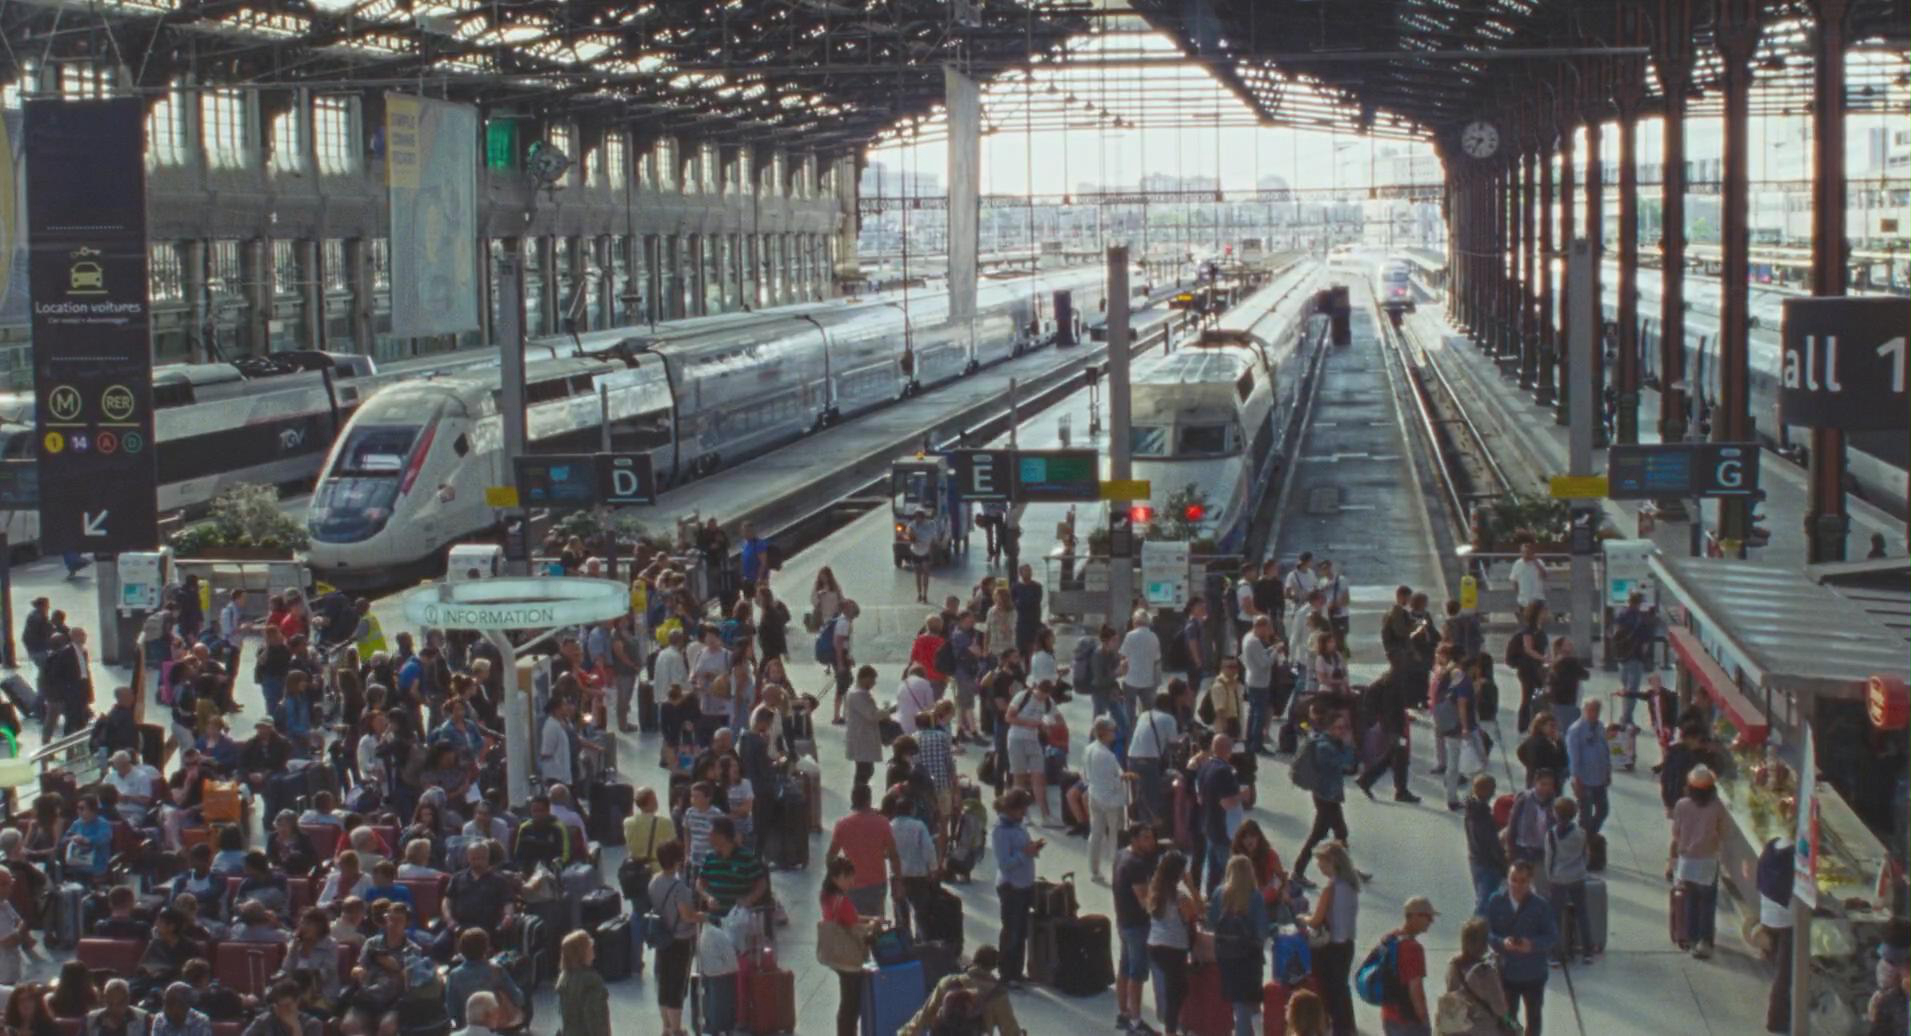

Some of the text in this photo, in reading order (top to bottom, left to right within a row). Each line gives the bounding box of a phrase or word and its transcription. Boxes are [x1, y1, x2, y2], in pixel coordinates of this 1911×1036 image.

[36, 301, 142, 313] Location voitures
[1876, 336, 1906, 392] 1
[56, 393, 130, 412] M RER
[71, 436, 88, 449] 14
[612, 469, 638, 496] D
[972, 465, 994, 492] E
[1716, 460, 1742, 487] G
[443, 607, 554, 624] INFORMATION
